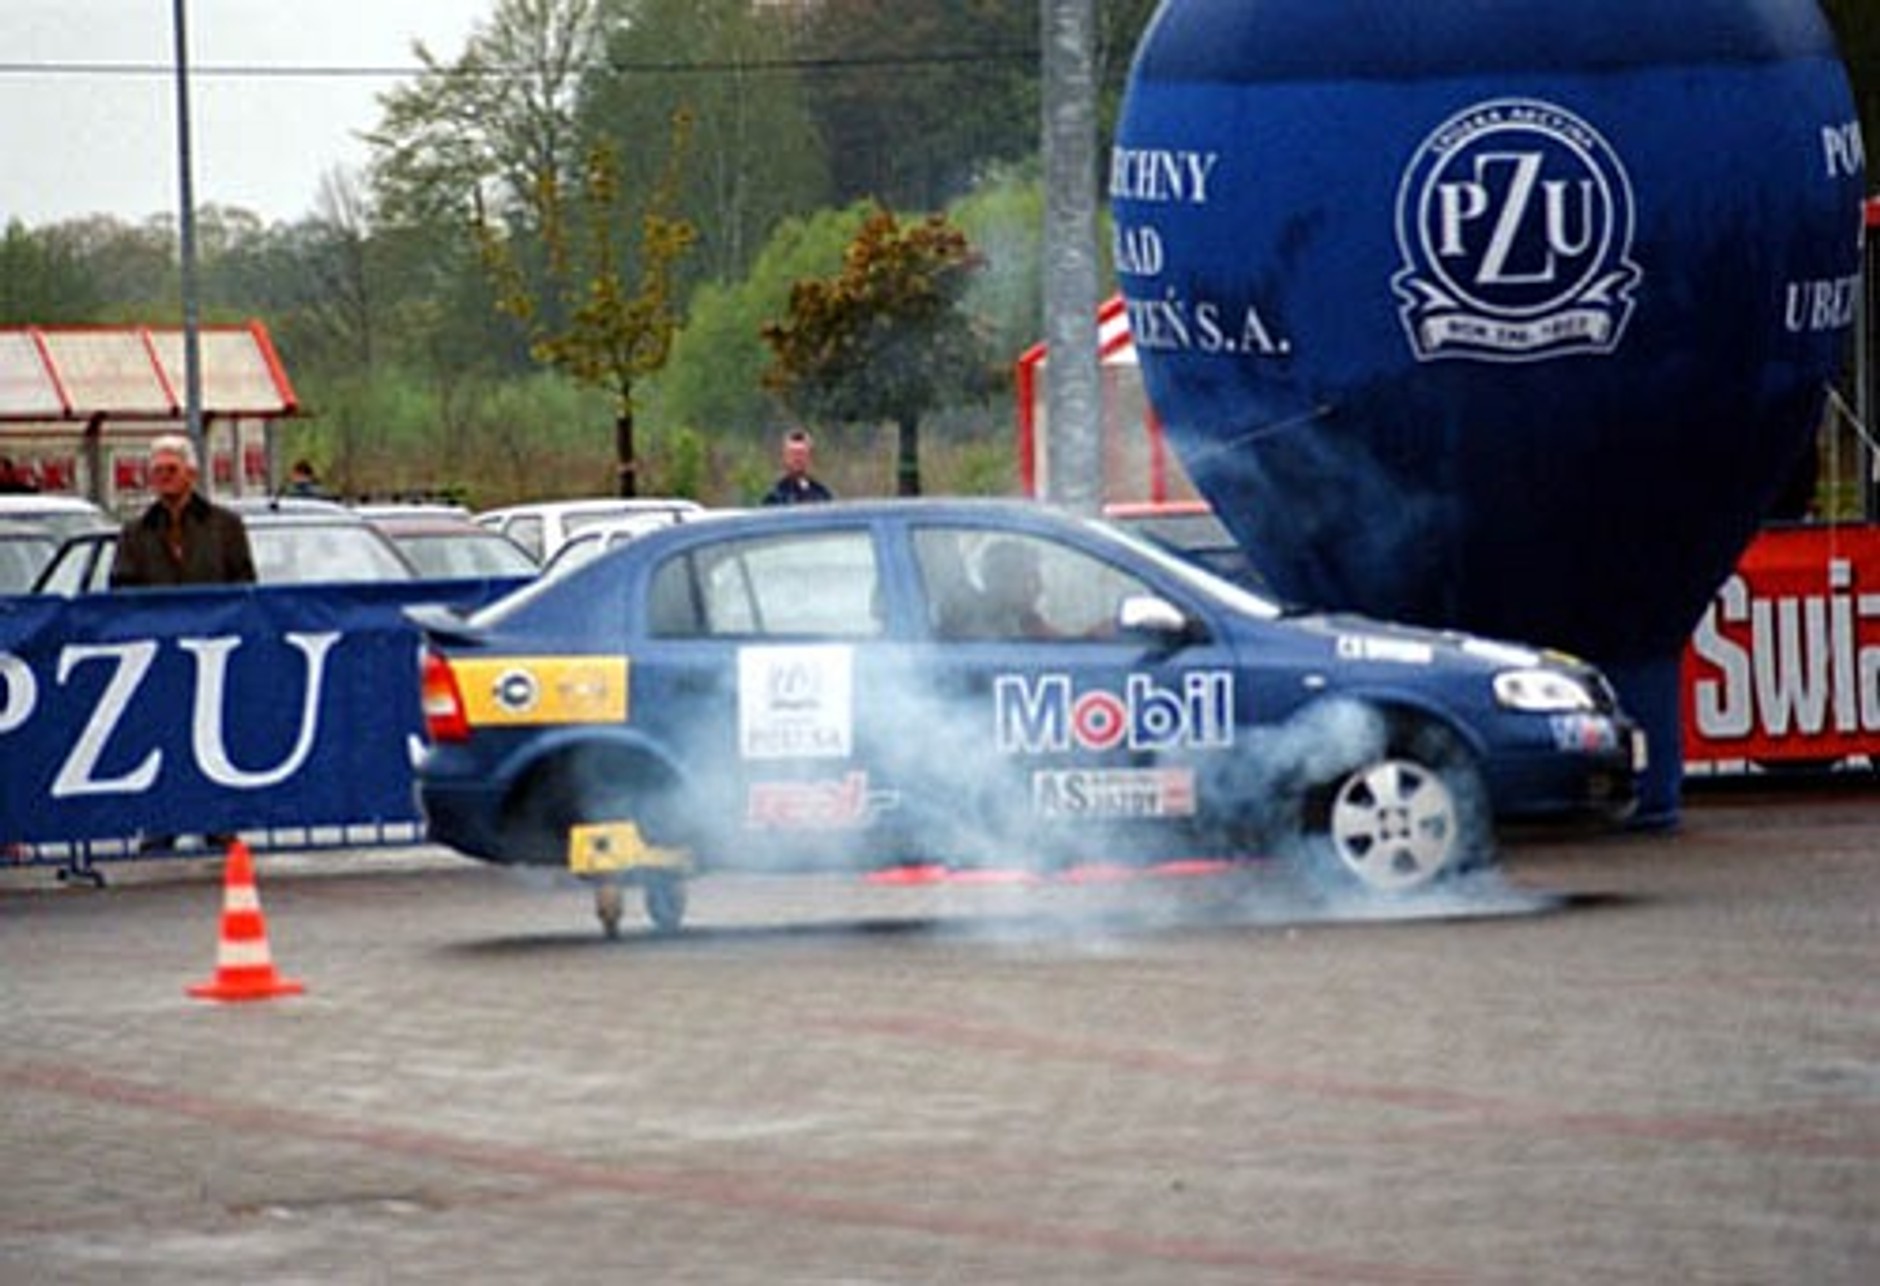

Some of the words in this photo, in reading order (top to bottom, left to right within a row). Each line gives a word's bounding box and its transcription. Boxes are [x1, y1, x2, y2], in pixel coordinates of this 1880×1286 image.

[1821, 121, 1866, 178] PO
[1438, 151, 1595, 284] PZU
[994, 671, 1235, 752] Mobil
